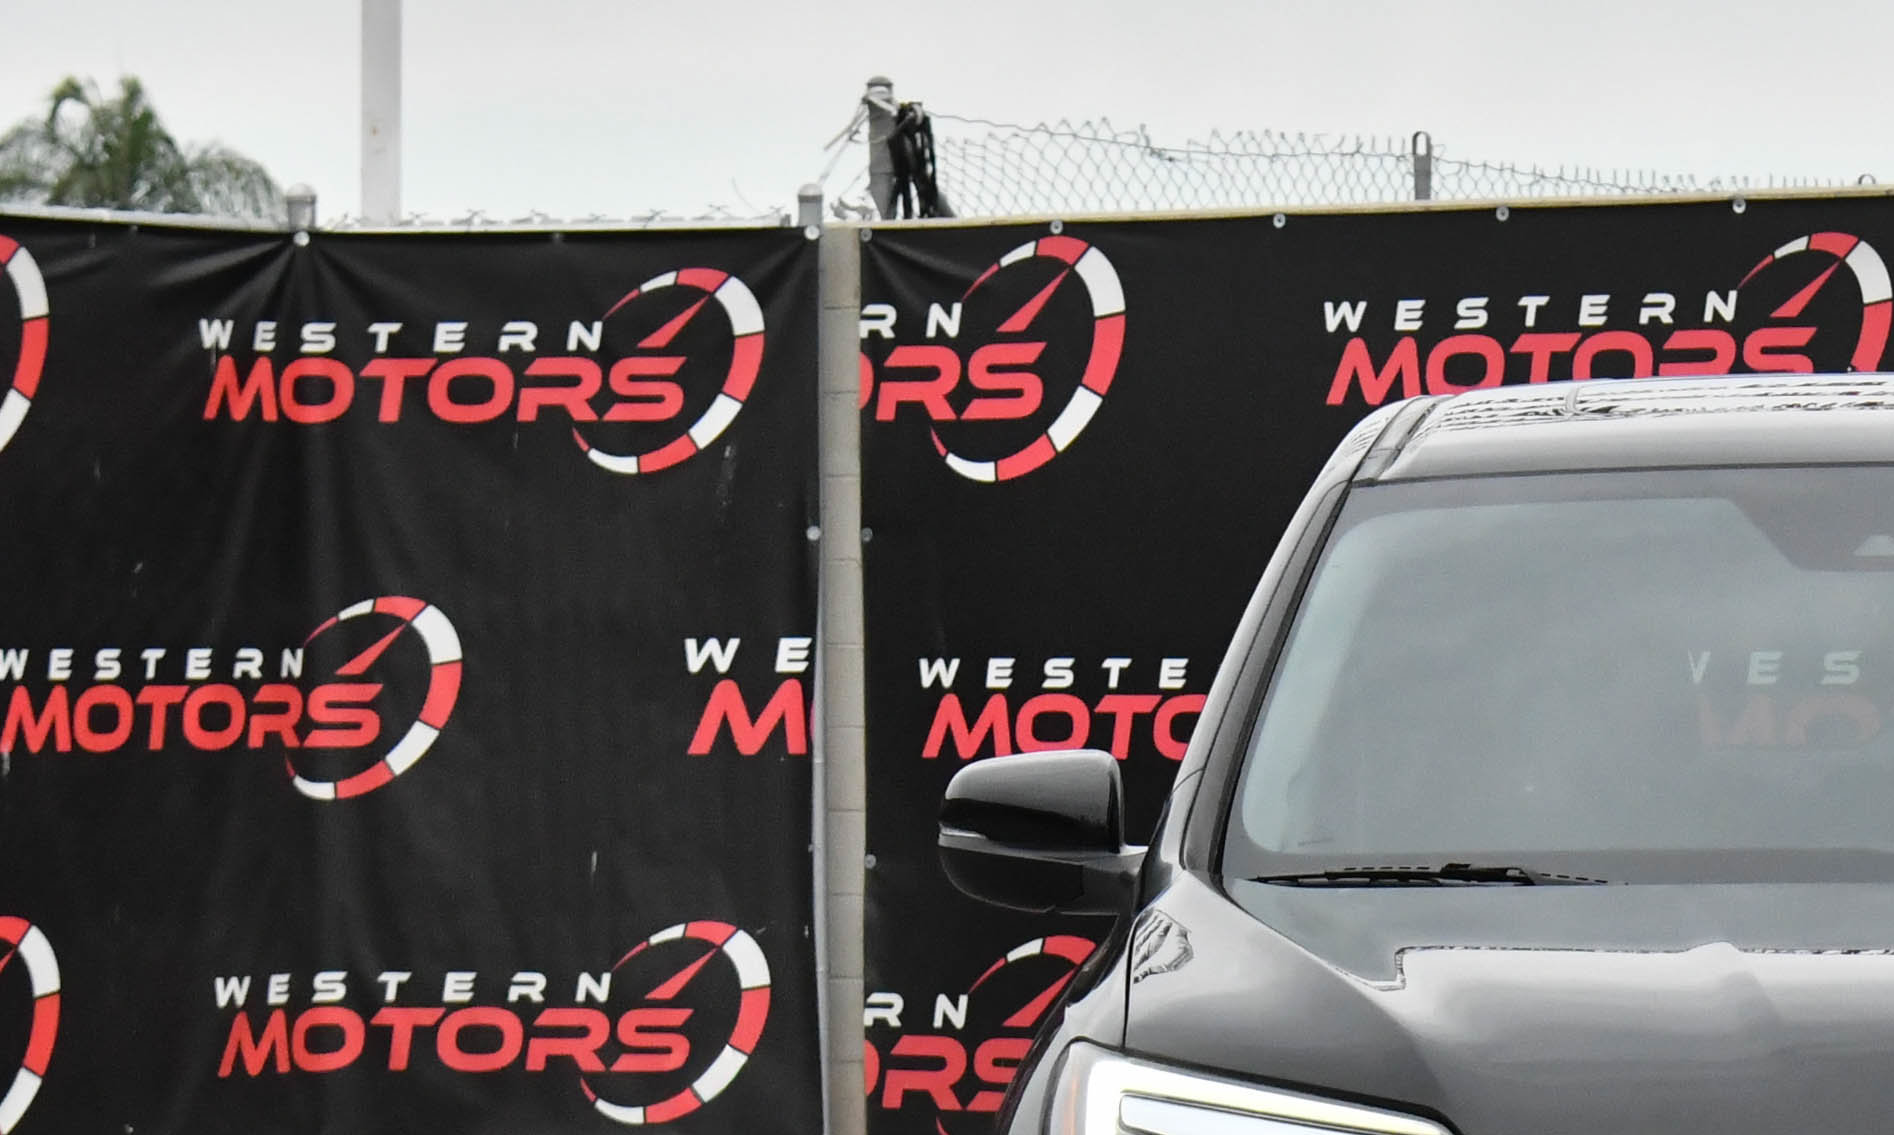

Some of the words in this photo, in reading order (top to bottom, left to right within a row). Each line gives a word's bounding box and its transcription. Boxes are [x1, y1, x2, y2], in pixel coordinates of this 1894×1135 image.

[199, 318, 603, 353] WESTERN
[1323, 289, 1738, 333] WESTERN
[204, 355, 686, 424] MOTORS
[859, 341, 1047, 422] RS
[1326, 326, 1817, 406] MOTORS
[0, 648, 304, 681] WESTERN
[0, 683, 384, 753] MOTORS
[687, 678, 815, 756] M
[214, 971, 612, 1008] WESTERN
[218, 1006, 694, 1078] MOTORS
